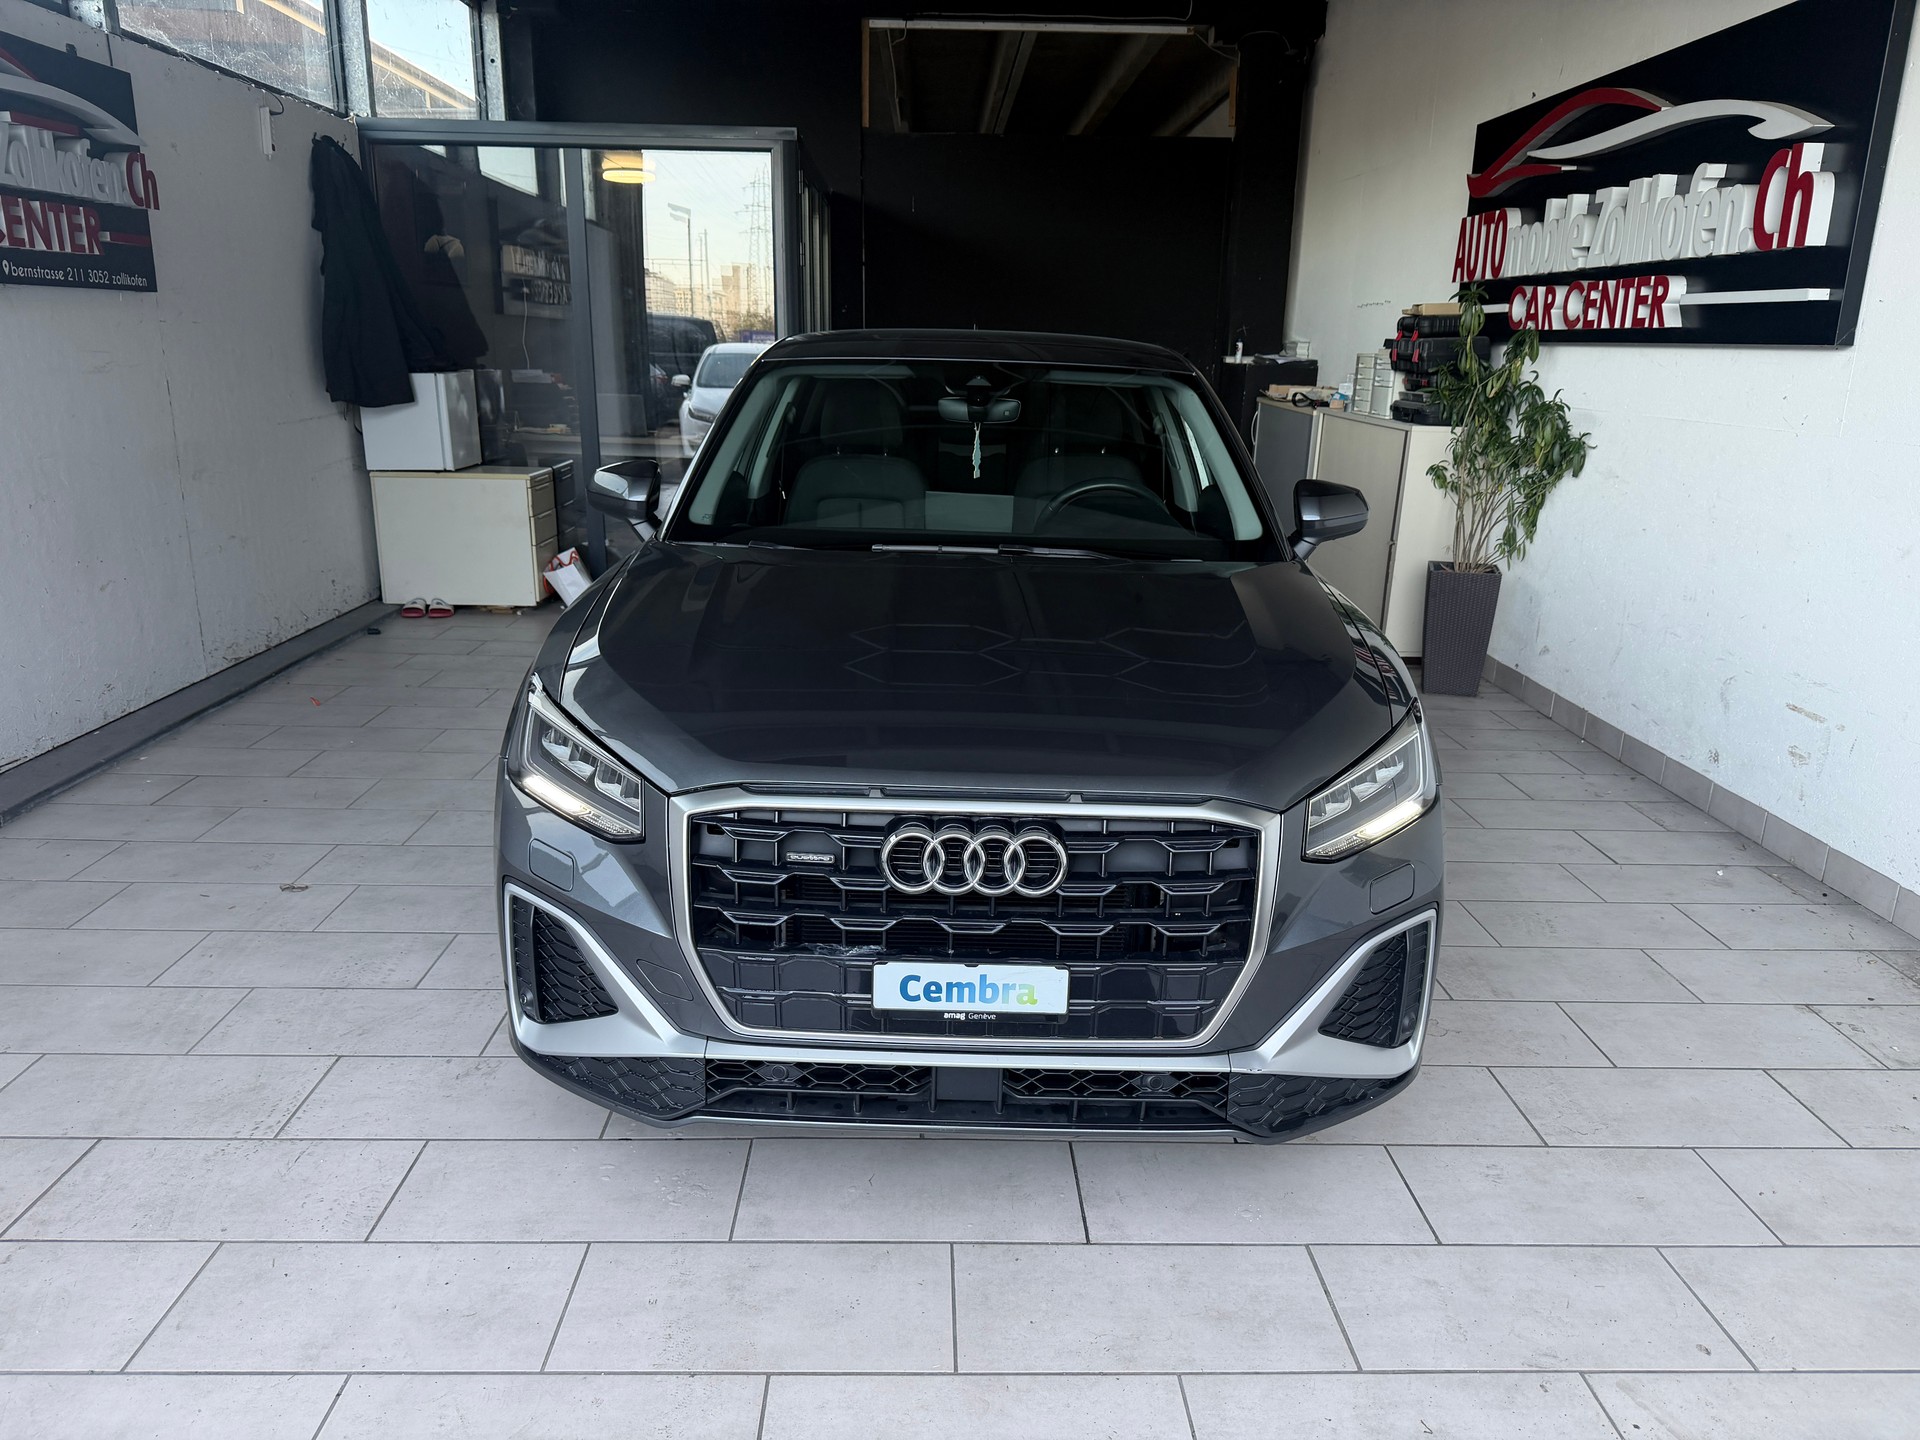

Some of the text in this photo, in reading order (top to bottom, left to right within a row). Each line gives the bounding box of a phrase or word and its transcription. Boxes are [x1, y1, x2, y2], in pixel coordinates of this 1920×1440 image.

[0, 195, 104, 255] ENTER
[10, 261, 148, 287] bernstrasse 211 3052 zollikofen
[1508, 276, 1672, 331] CAR CENTER
[899, 973, 1038, 1006] Cembra
[943, 1012, 966, 1021] amag
